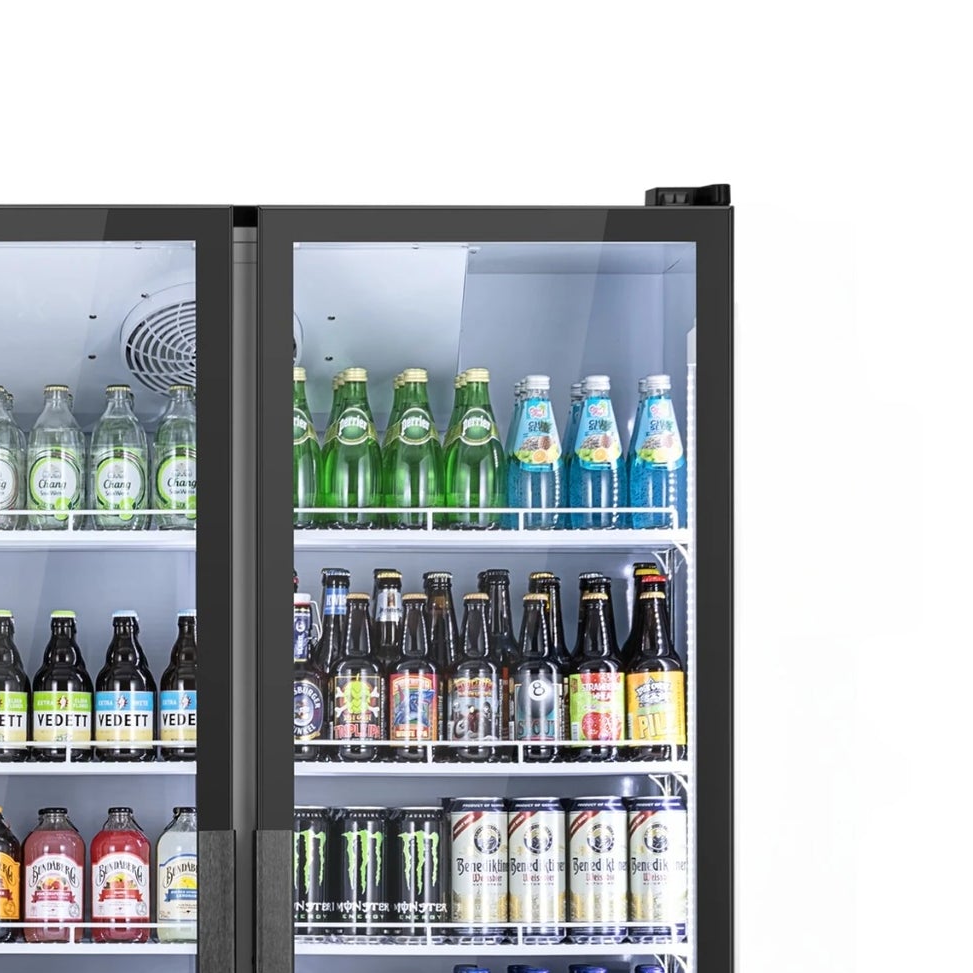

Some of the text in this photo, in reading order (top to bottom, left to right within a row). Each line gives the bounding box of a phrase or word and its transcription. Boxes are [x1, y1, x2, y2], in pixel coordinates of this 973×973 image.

[338, 415, 368, 437] perrier
[401, 415, 430, 437] perrier
[462, 415, 491, 437] perrier
[532, 682, 545, 698] 8
[37, 713, 88, 727] VEDETT
[98, 713, 148, 727] VEDETT
